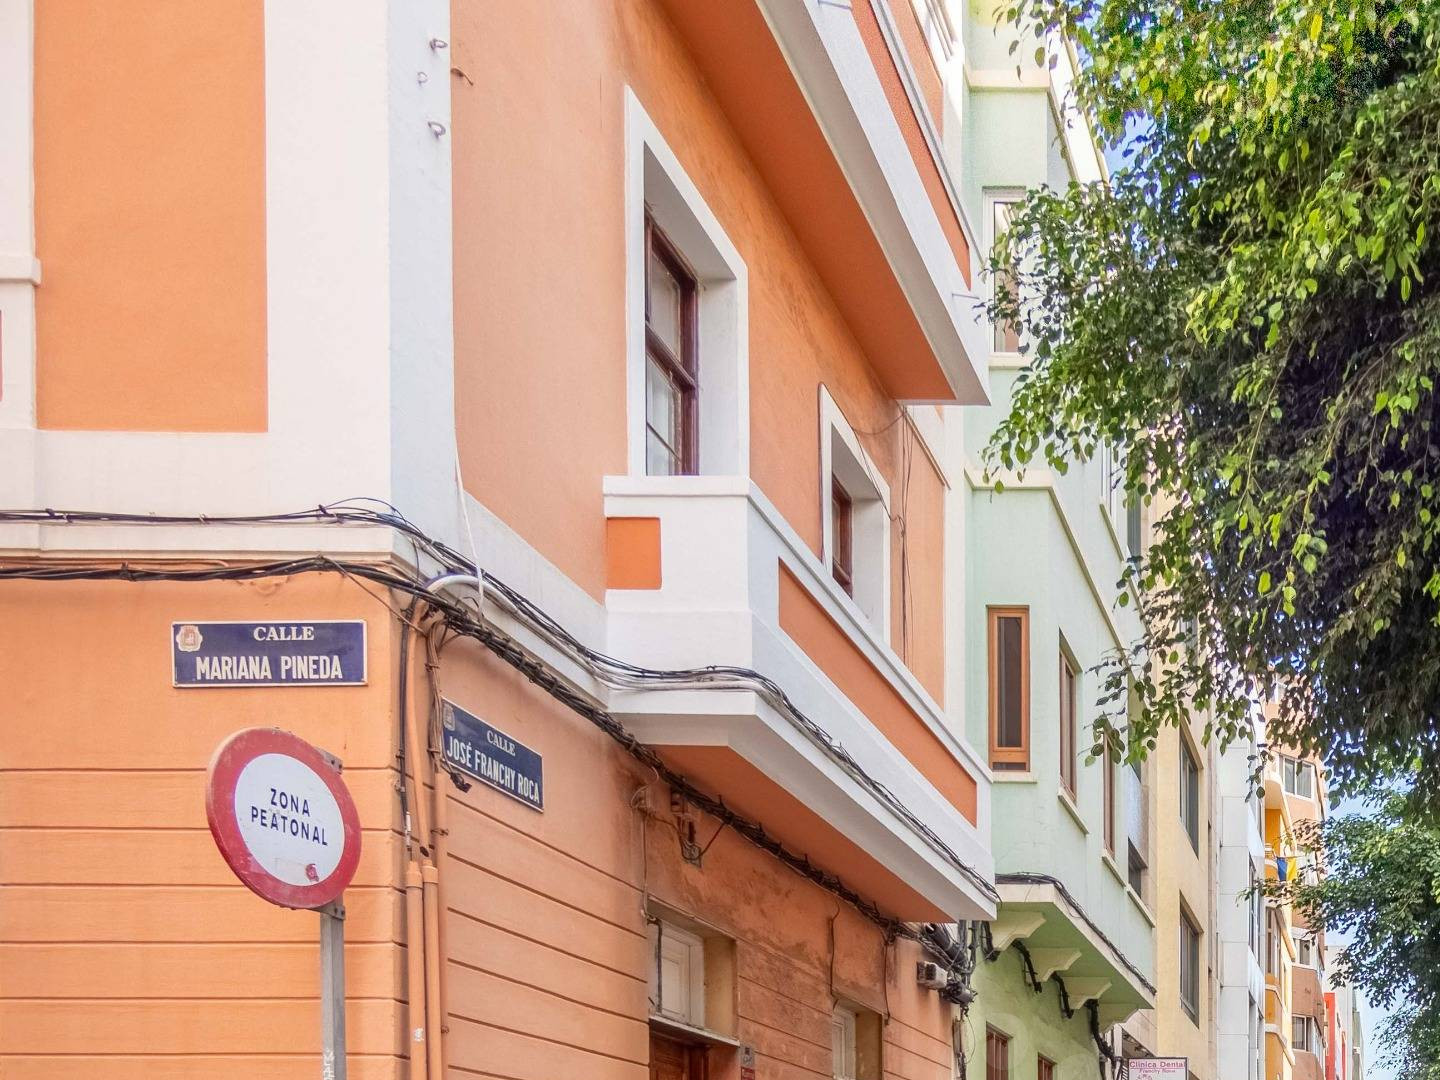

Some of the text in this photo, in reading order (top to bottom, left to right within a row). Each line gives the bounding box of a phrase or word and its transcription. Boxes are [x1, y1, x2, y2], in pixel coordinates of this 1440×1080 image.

[253, 626, 314, 641] CALLE
[196, 655, 343, 680] MARIANA PINEDA
[486, 730, 515, 756] CALLE
[447, 736, 540, 803] JOSÉ FRANCHY ROCA
[270, 787, 310, 818] ZONA
[251, 805, 329, 847] PEATONAL
